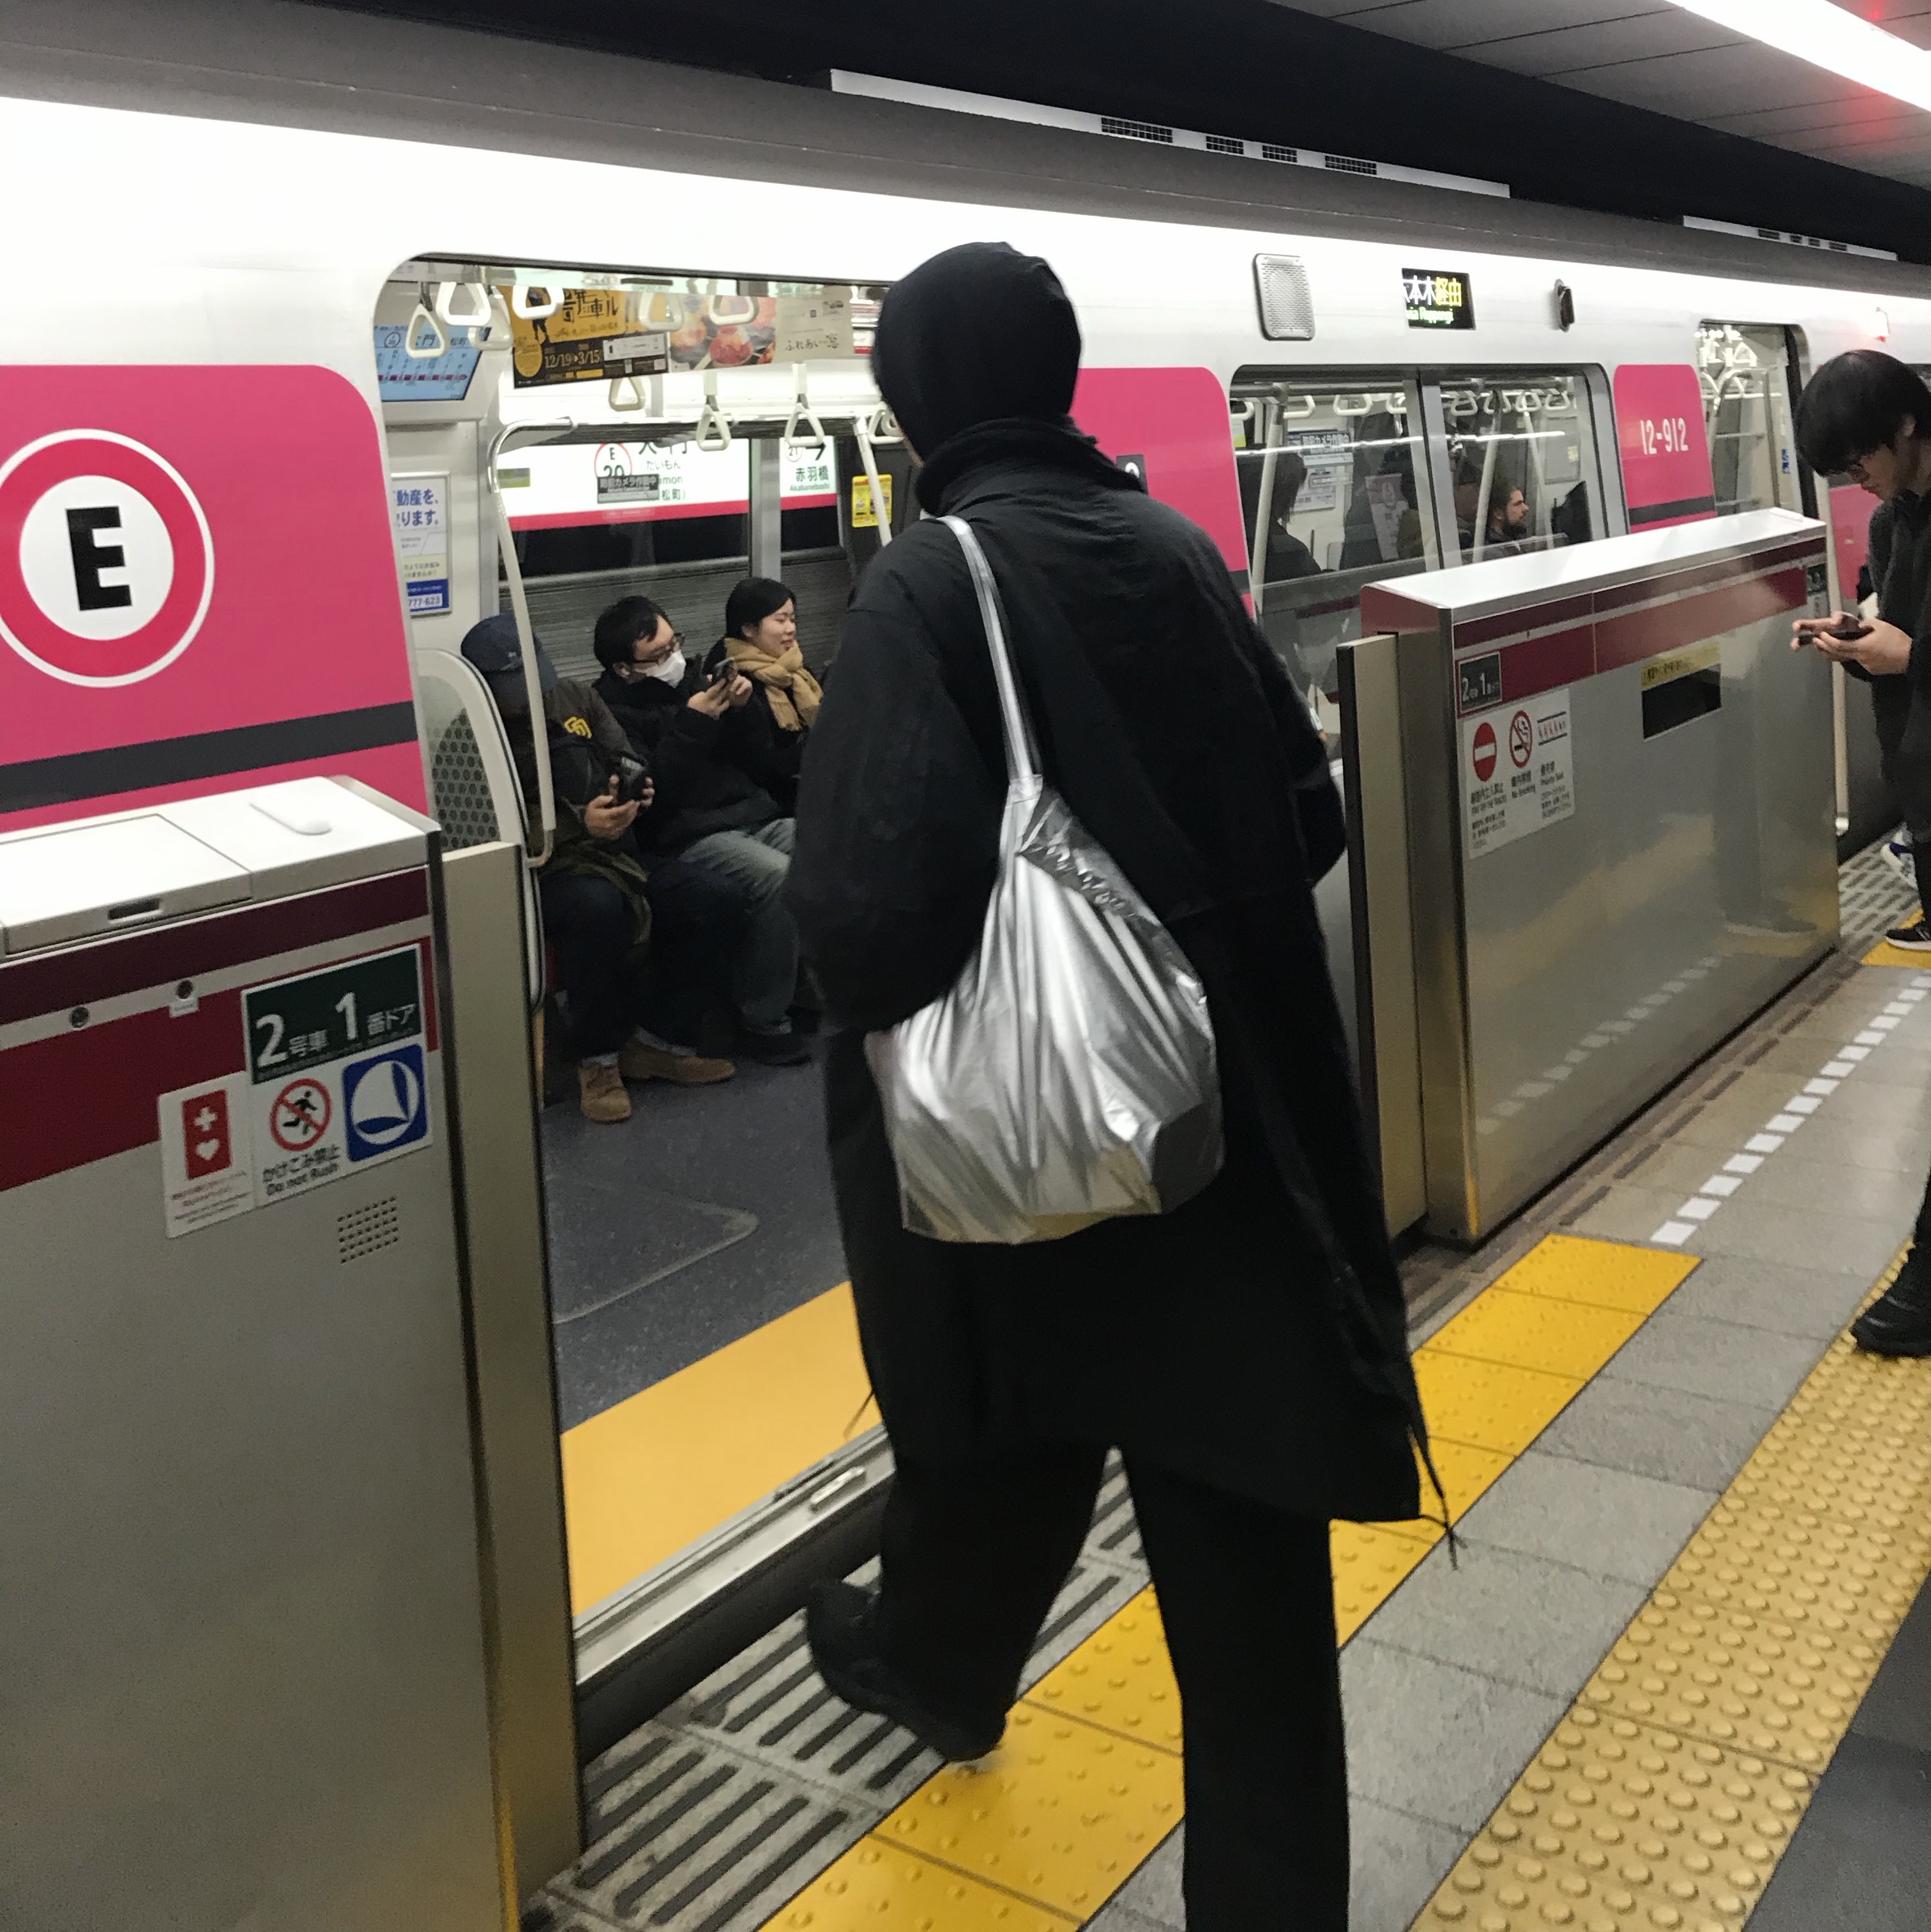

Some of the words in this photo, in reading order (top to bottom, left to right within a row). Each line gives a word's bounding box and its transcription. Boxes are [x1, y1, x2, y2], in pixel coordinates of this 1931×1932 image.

[1640, 417, 1689, 455] 12-912
[609, 447, 616, 460] E
[796, 465, 829, 482] 赤羽橋
[395, 488, 439, 506] 動産を、
[66, 506, 133, 611] E
